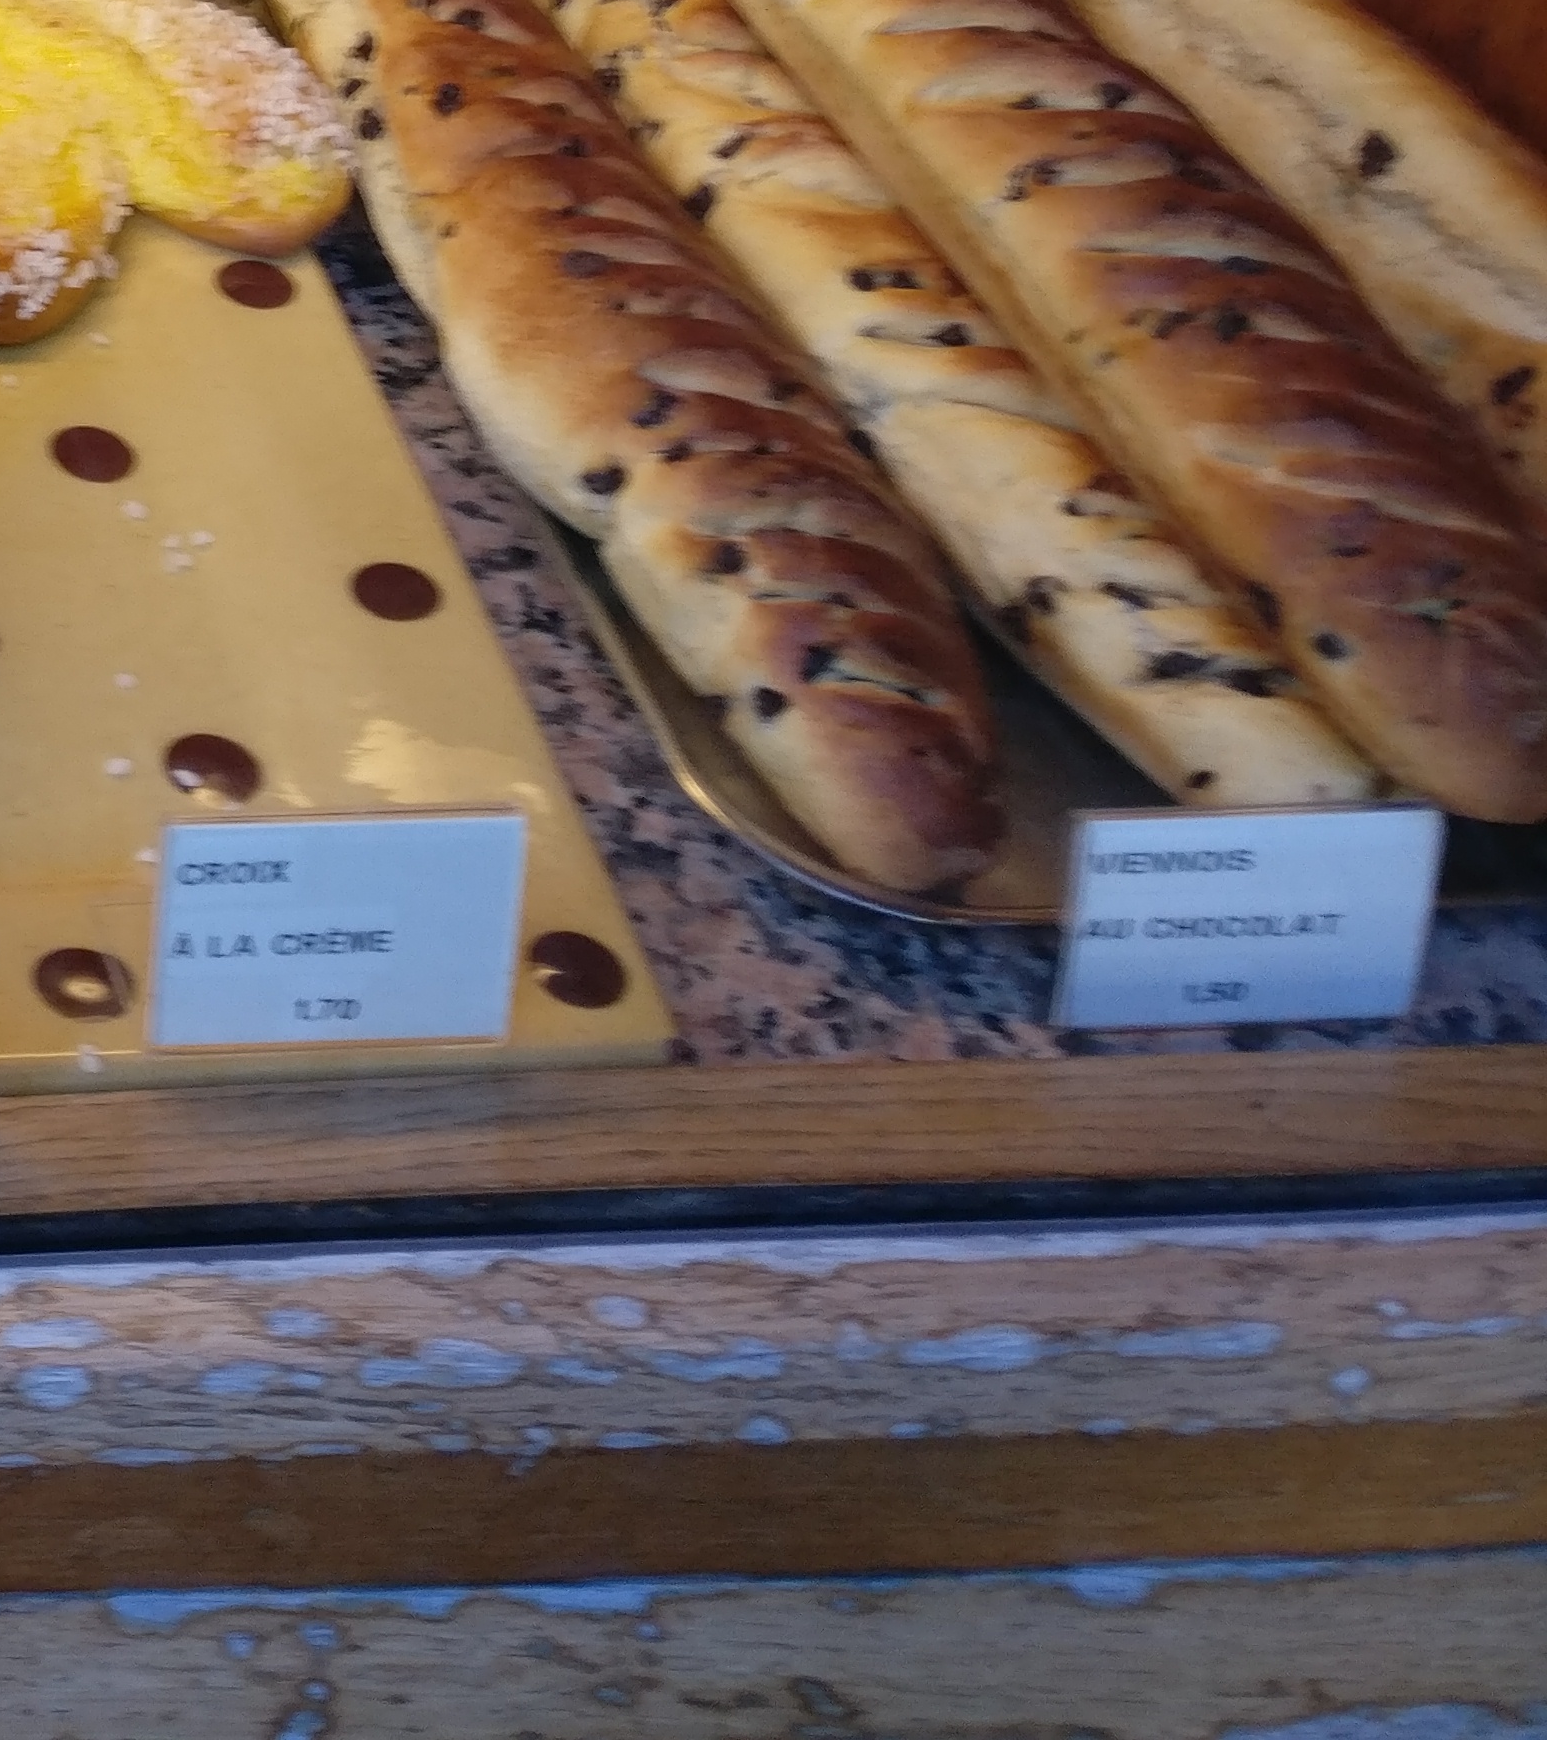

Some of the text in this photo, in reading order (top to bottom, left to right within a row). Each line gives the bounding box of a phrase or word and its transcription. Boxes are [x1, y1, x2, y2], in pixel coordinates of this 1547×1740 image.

[176, 860, 292, 885] CROIX
[1143, 913, 1346, 939] CHOCOLAT
[207, 934, 259, 958] LA
